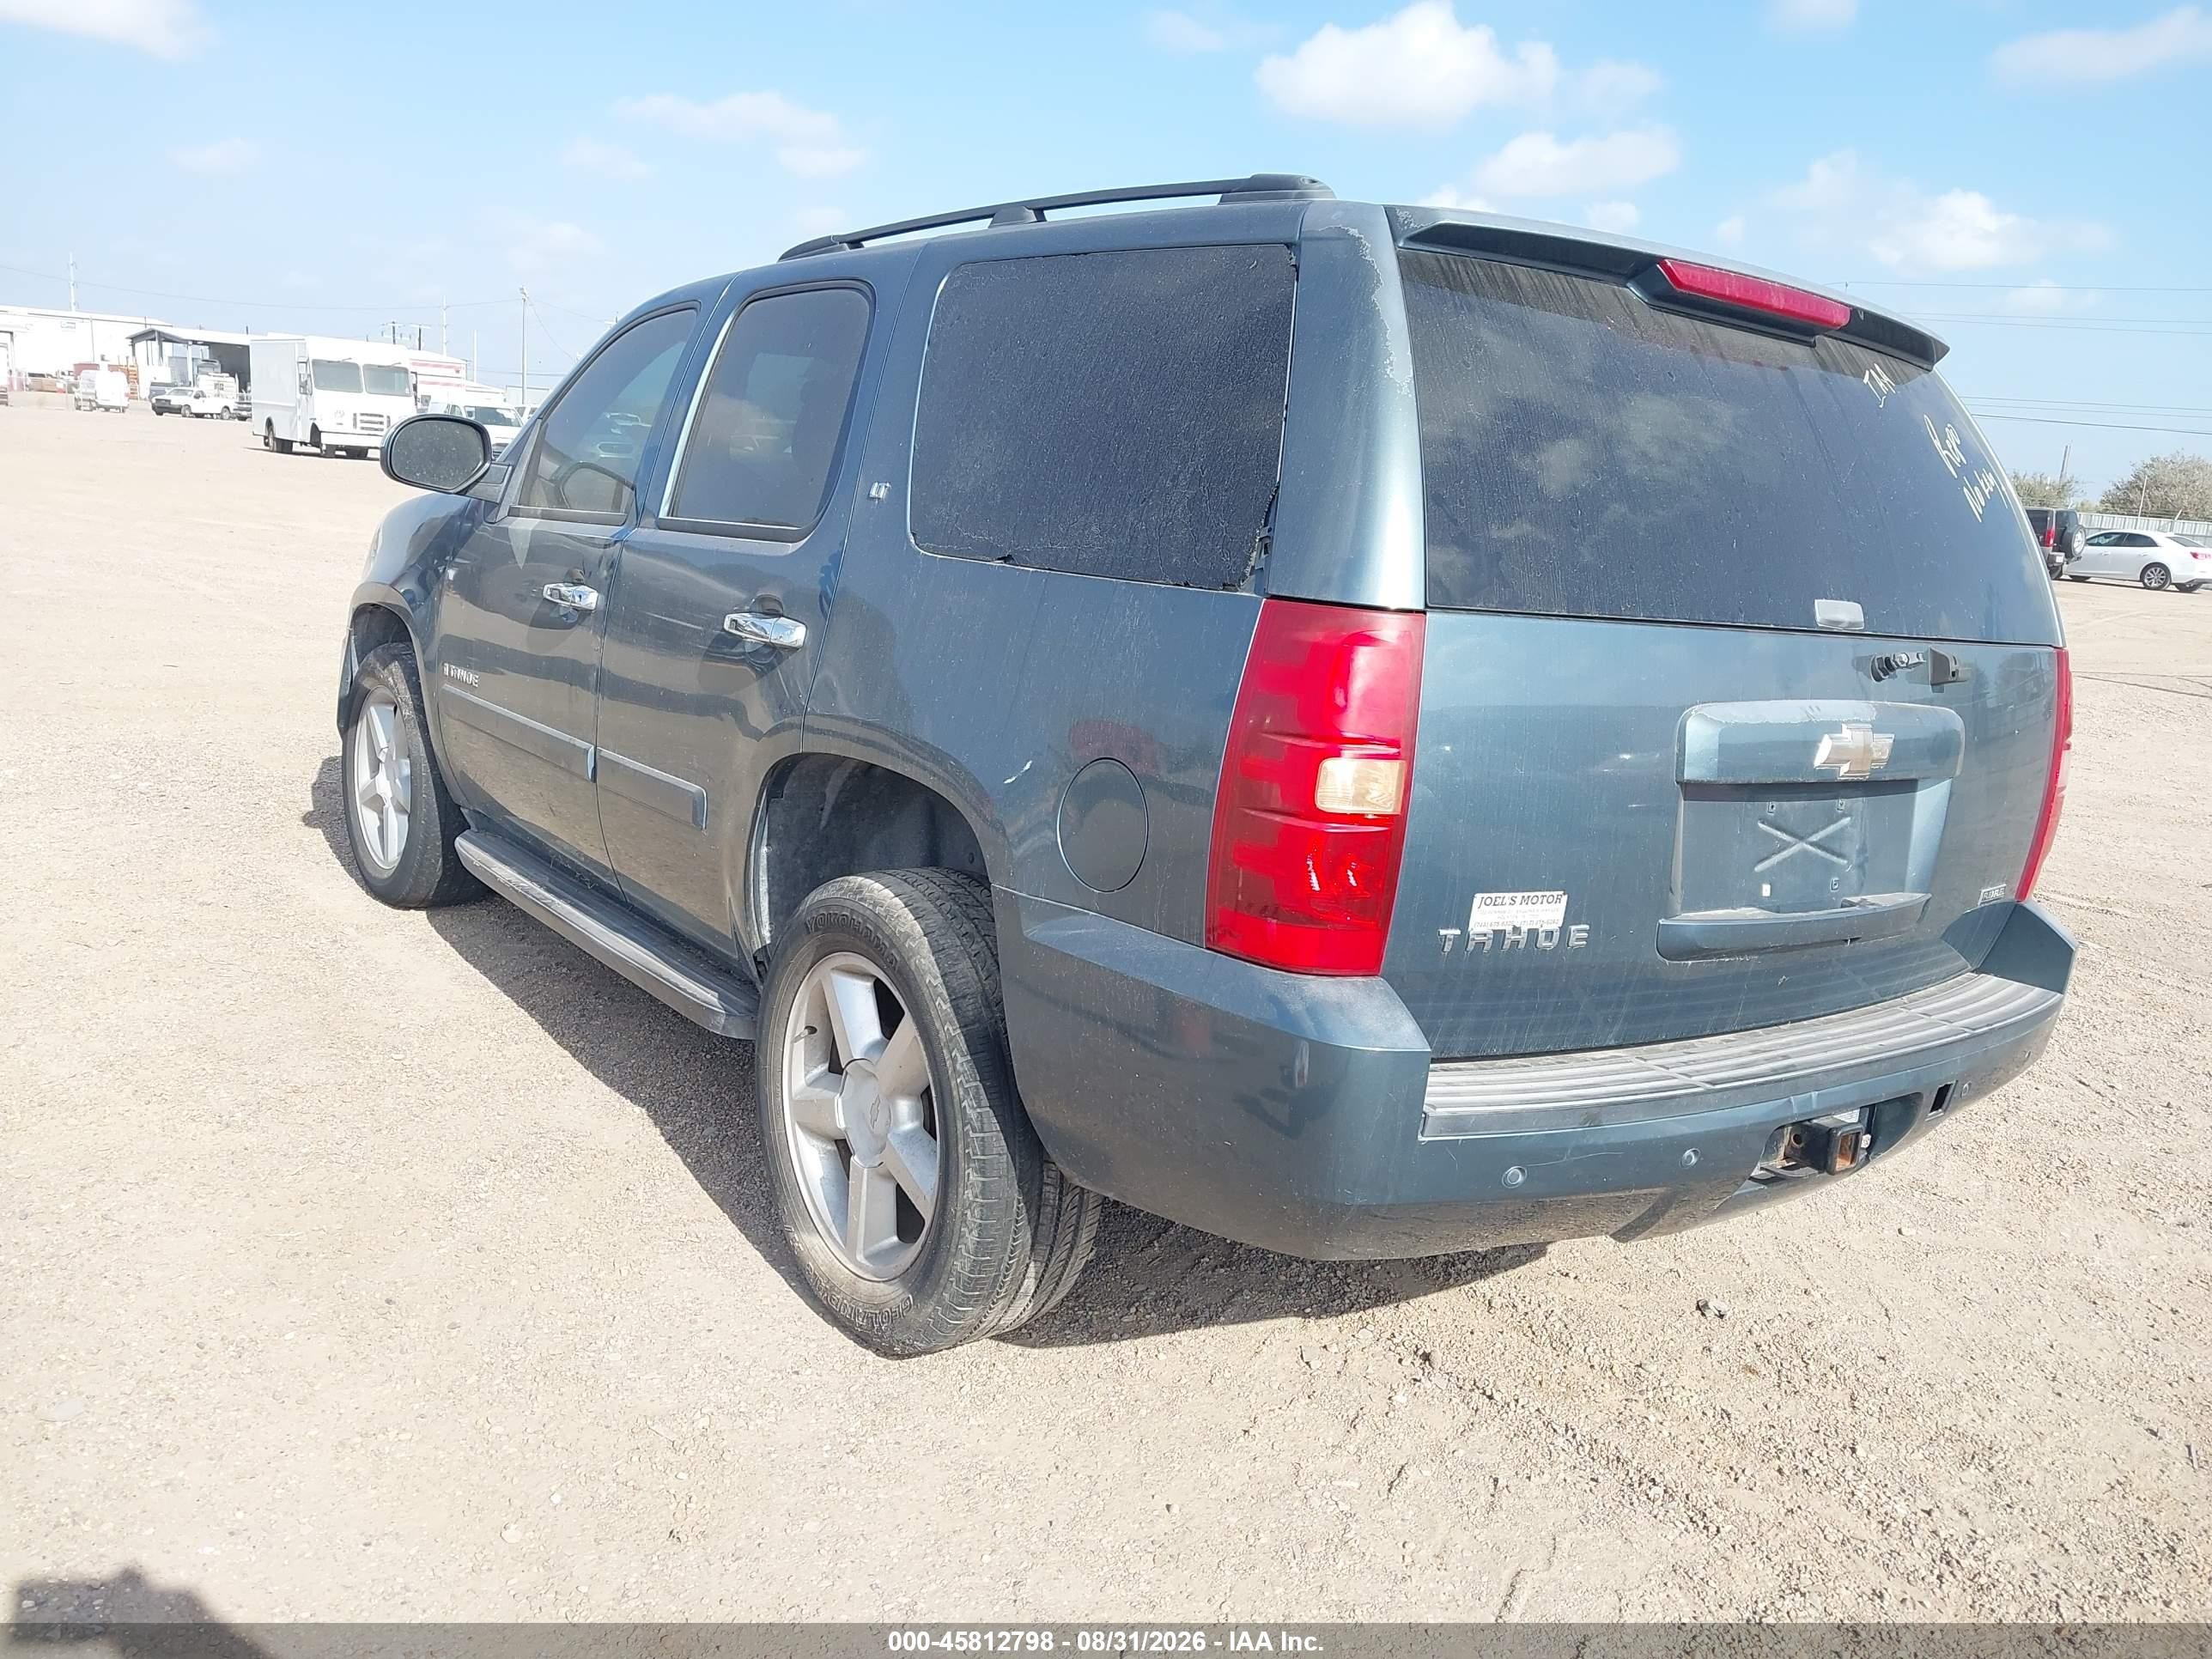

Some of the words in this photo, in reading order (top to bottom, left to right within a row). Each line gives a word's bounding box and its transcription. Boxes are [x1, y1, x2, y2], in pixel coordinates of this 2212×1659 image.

[869, 481, 891, 499] LT
[1477, 896, 1517, 909] JOEL'S
[1519, 894, 1563, 906] MOTOR
[805, 911, 899, 973] YOKOHAMA
[1437, 924, 1590, 953] TAHOE
